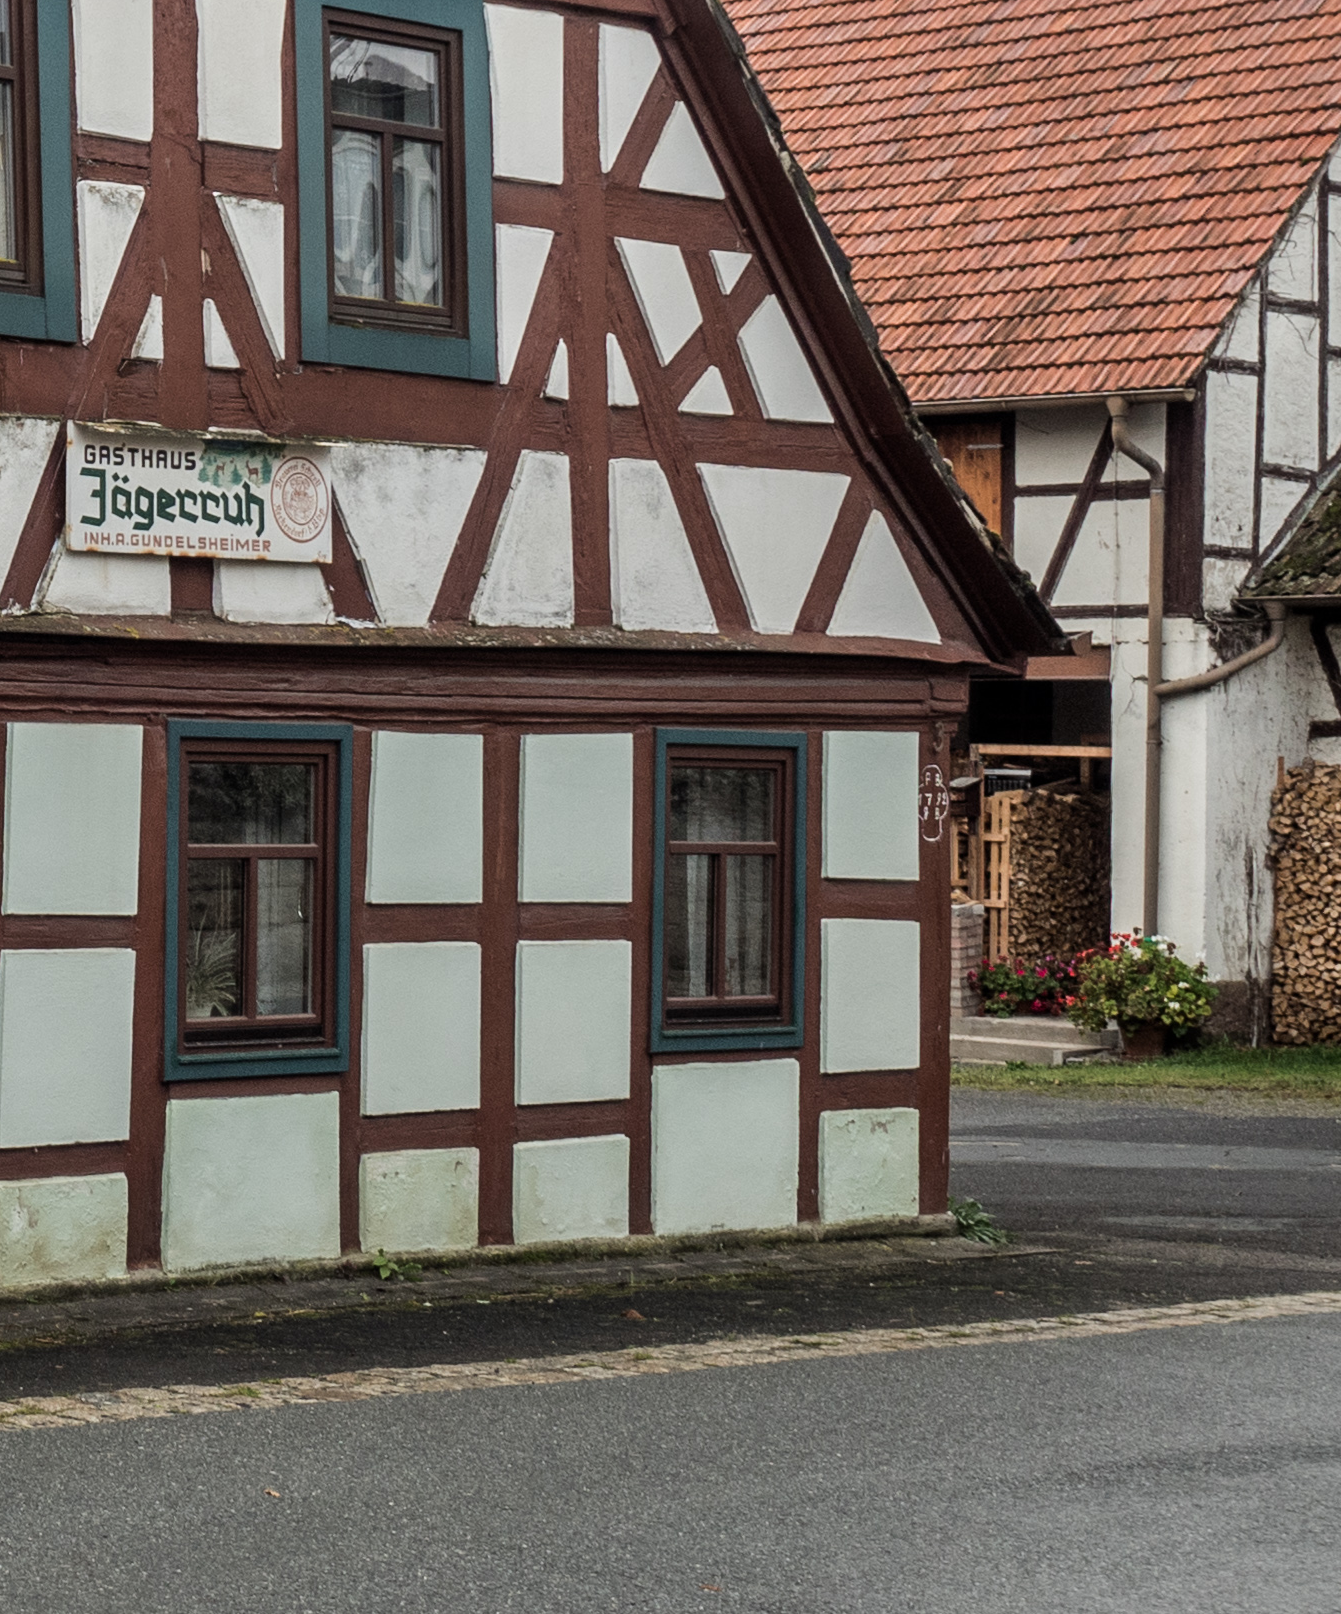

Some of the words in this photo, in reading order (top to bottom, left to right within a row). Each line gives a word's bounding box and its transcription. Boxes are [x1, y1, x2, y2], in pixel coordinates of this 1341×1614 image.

[84, 444, 197, 471] GASTHAUS
[79, 467, 266, 538] Jägerruh
[932, 722, 944, 752] 3
